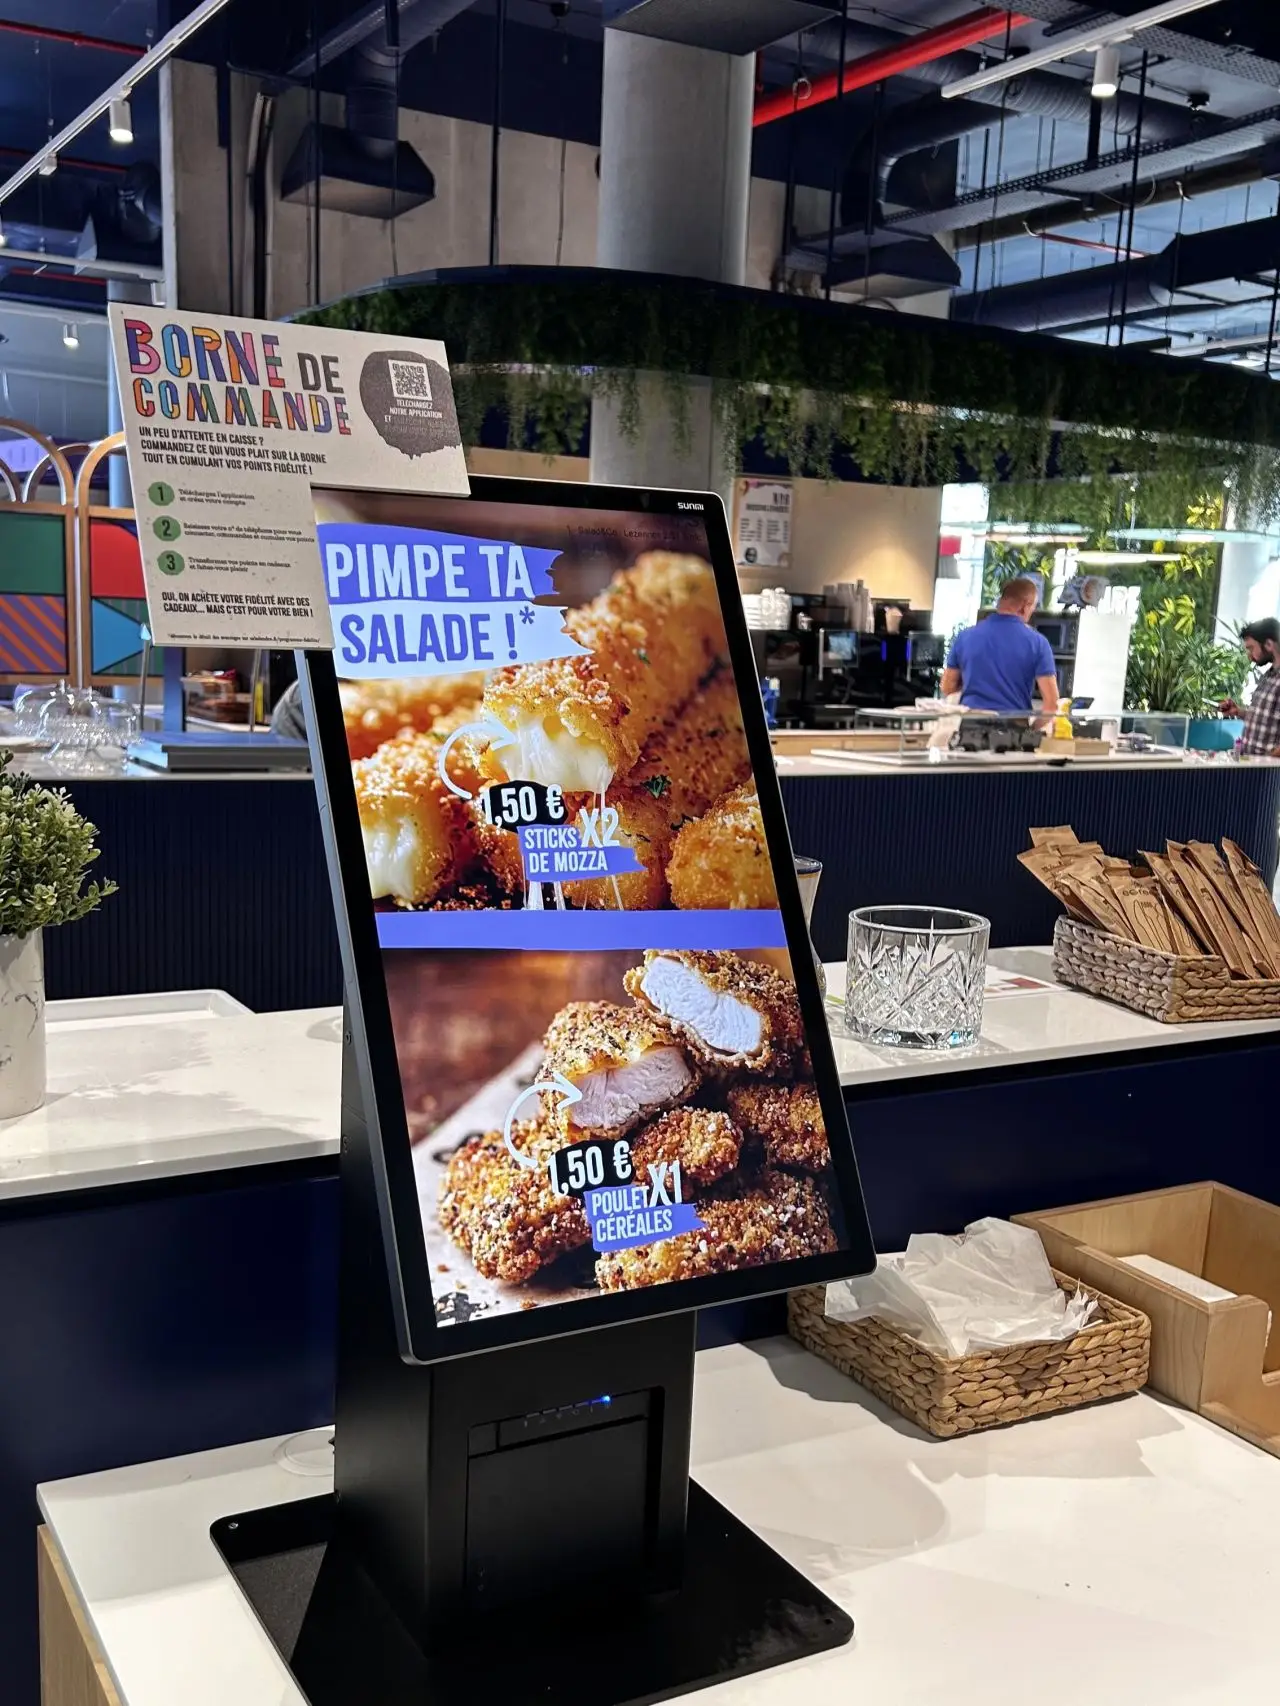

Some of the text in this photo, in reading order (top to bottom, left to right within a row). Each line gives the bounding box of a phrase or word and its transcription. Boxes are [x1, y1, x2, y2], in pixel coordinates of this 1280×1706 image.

[124, 318, 344, 394] BORNE DE
[133, 377, 352, 435] COMMANDE
[389, 407, 443, 419] NOTRE APPLICATION
[384, 414, 391, 423] ET
[139, 426, 264, 446] UN PEU D'ATTENTE EN CAISSE ?
[141, 440, 327, 464] COMMANDEZ CE QUI VOUS PLAIT SUR LA BORNE
[142, 452, 313, 475] TOUT EN CUMULANT VOS POINTS FIDÉLITÉ !
[157, 486, 164, 501] 1
[161, 519, 172, 537] 2
[166, 554, 175, 571] 3
[325, 543, 536, 599] PIMPE TA
[178, 592, 190, 602] ON
[191, 592, 220, 604] ACHÈTE
[220, 594, 245, 604] VOTRE
[245, 594, 276, 605] FIDÉLITÉ
[277, 596, 296, 606] AVEC
[296, 597, 310, 607] DES
[206, 605, 225, 615] MAIS
[226, 605, 246, 615] C'EST
[248, 606, 268, 616] POUR
[268, 607, 292, 617] VOTRE
[292, 608, 309, 618] BIEN
[310, 608, 314, 618] !
[340, 613, 494, 664] SALADE
[480, 783, 564, 829] 1,50 €
[524, 807, 620, 849] STICKS X2
[529, 850, 608, 873] DE MOZZA
[546, 1140, 632, 1197] 1,50 €
[592, 1160, 683, 1216] POULET X1
[596, 1208, 673, 1243] CÉRÉALES
